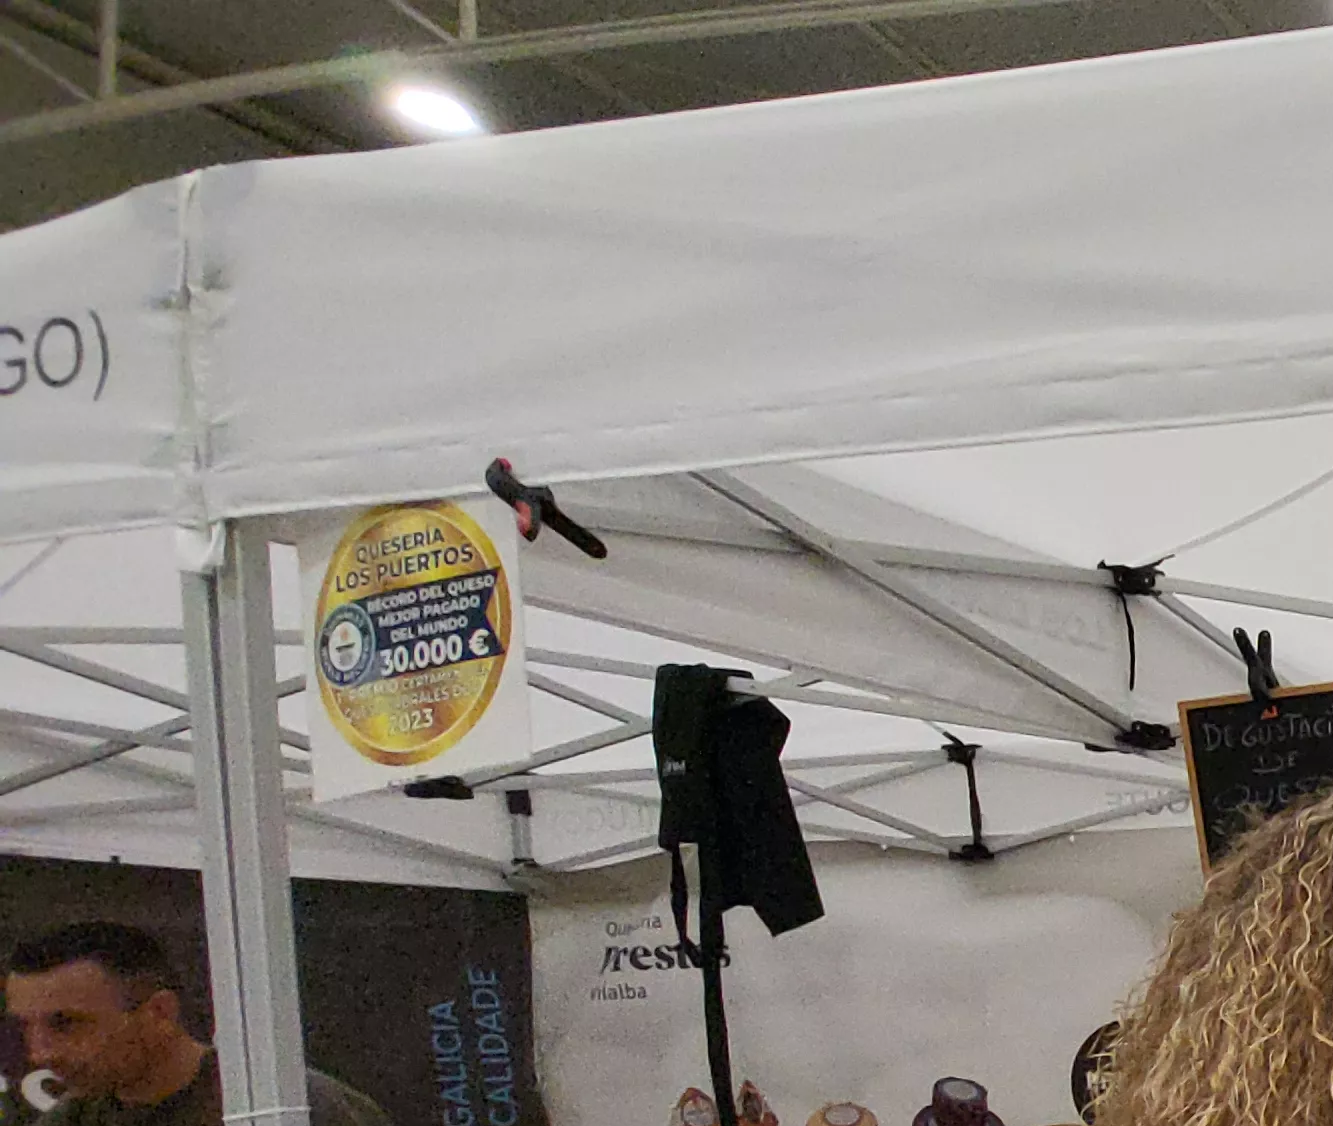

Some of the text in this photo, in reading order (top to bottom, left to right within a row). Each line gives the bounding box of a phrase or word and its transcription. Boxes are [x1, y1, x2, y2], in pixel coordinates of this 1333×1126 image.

[356, 526, 445, 565] QUESERÍA
[335, 543, 474, 593] LOS PUERTOS
[447, 574, 495, 597] QUESO
[423, 595, 481, 619] PAGADO
[390, 616, 469, 644] DEL MUNDO
[379, 634, 463, 677] 30.000
[468, 629, 491, 656] €
